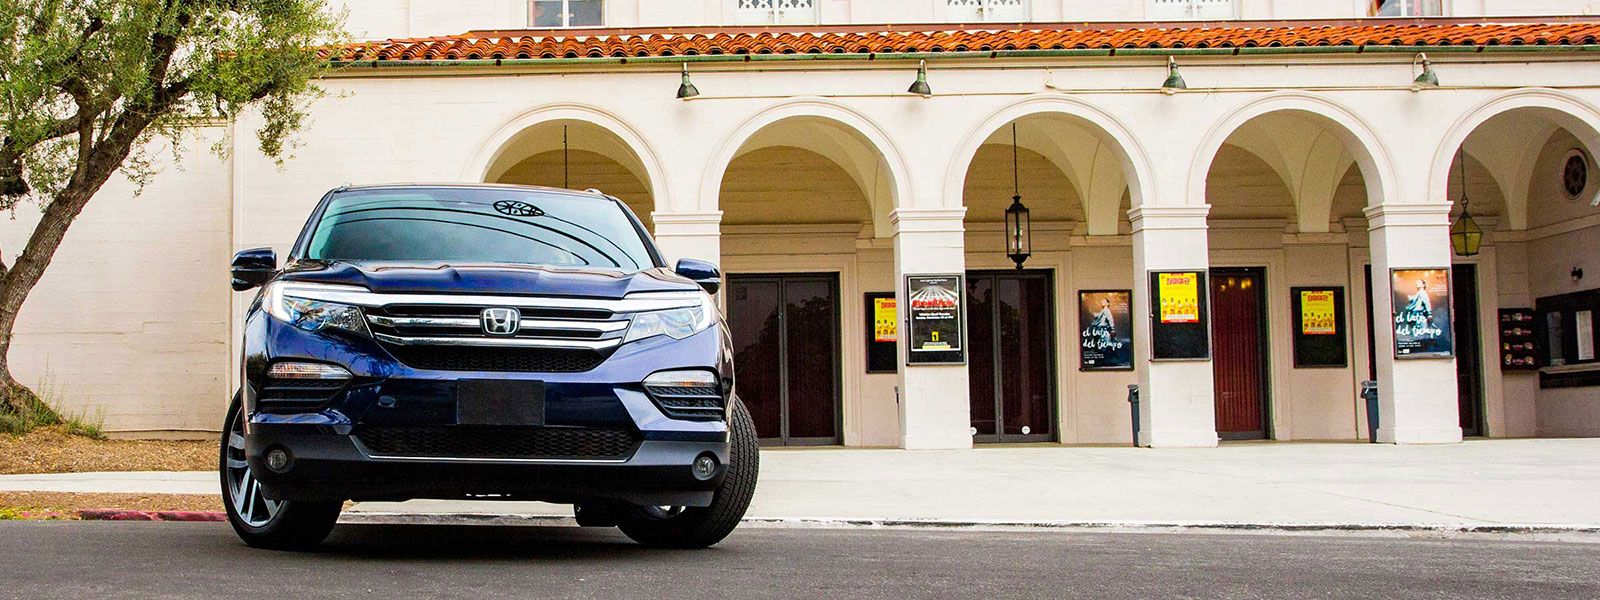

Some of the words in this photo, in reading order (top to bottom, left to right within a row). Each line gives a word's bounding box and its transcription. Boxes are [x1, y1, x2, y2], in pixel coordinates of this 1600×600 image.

[1396, 312, 1404, 323] el
[1083, 327, 1091, 337] el
[1396, 325, 1411, 335] del
[1413, 326, 1442, 338] tiempo
[1083, 339, 1095, 348] del
[1097, 339, 1122, 351] tiempo
